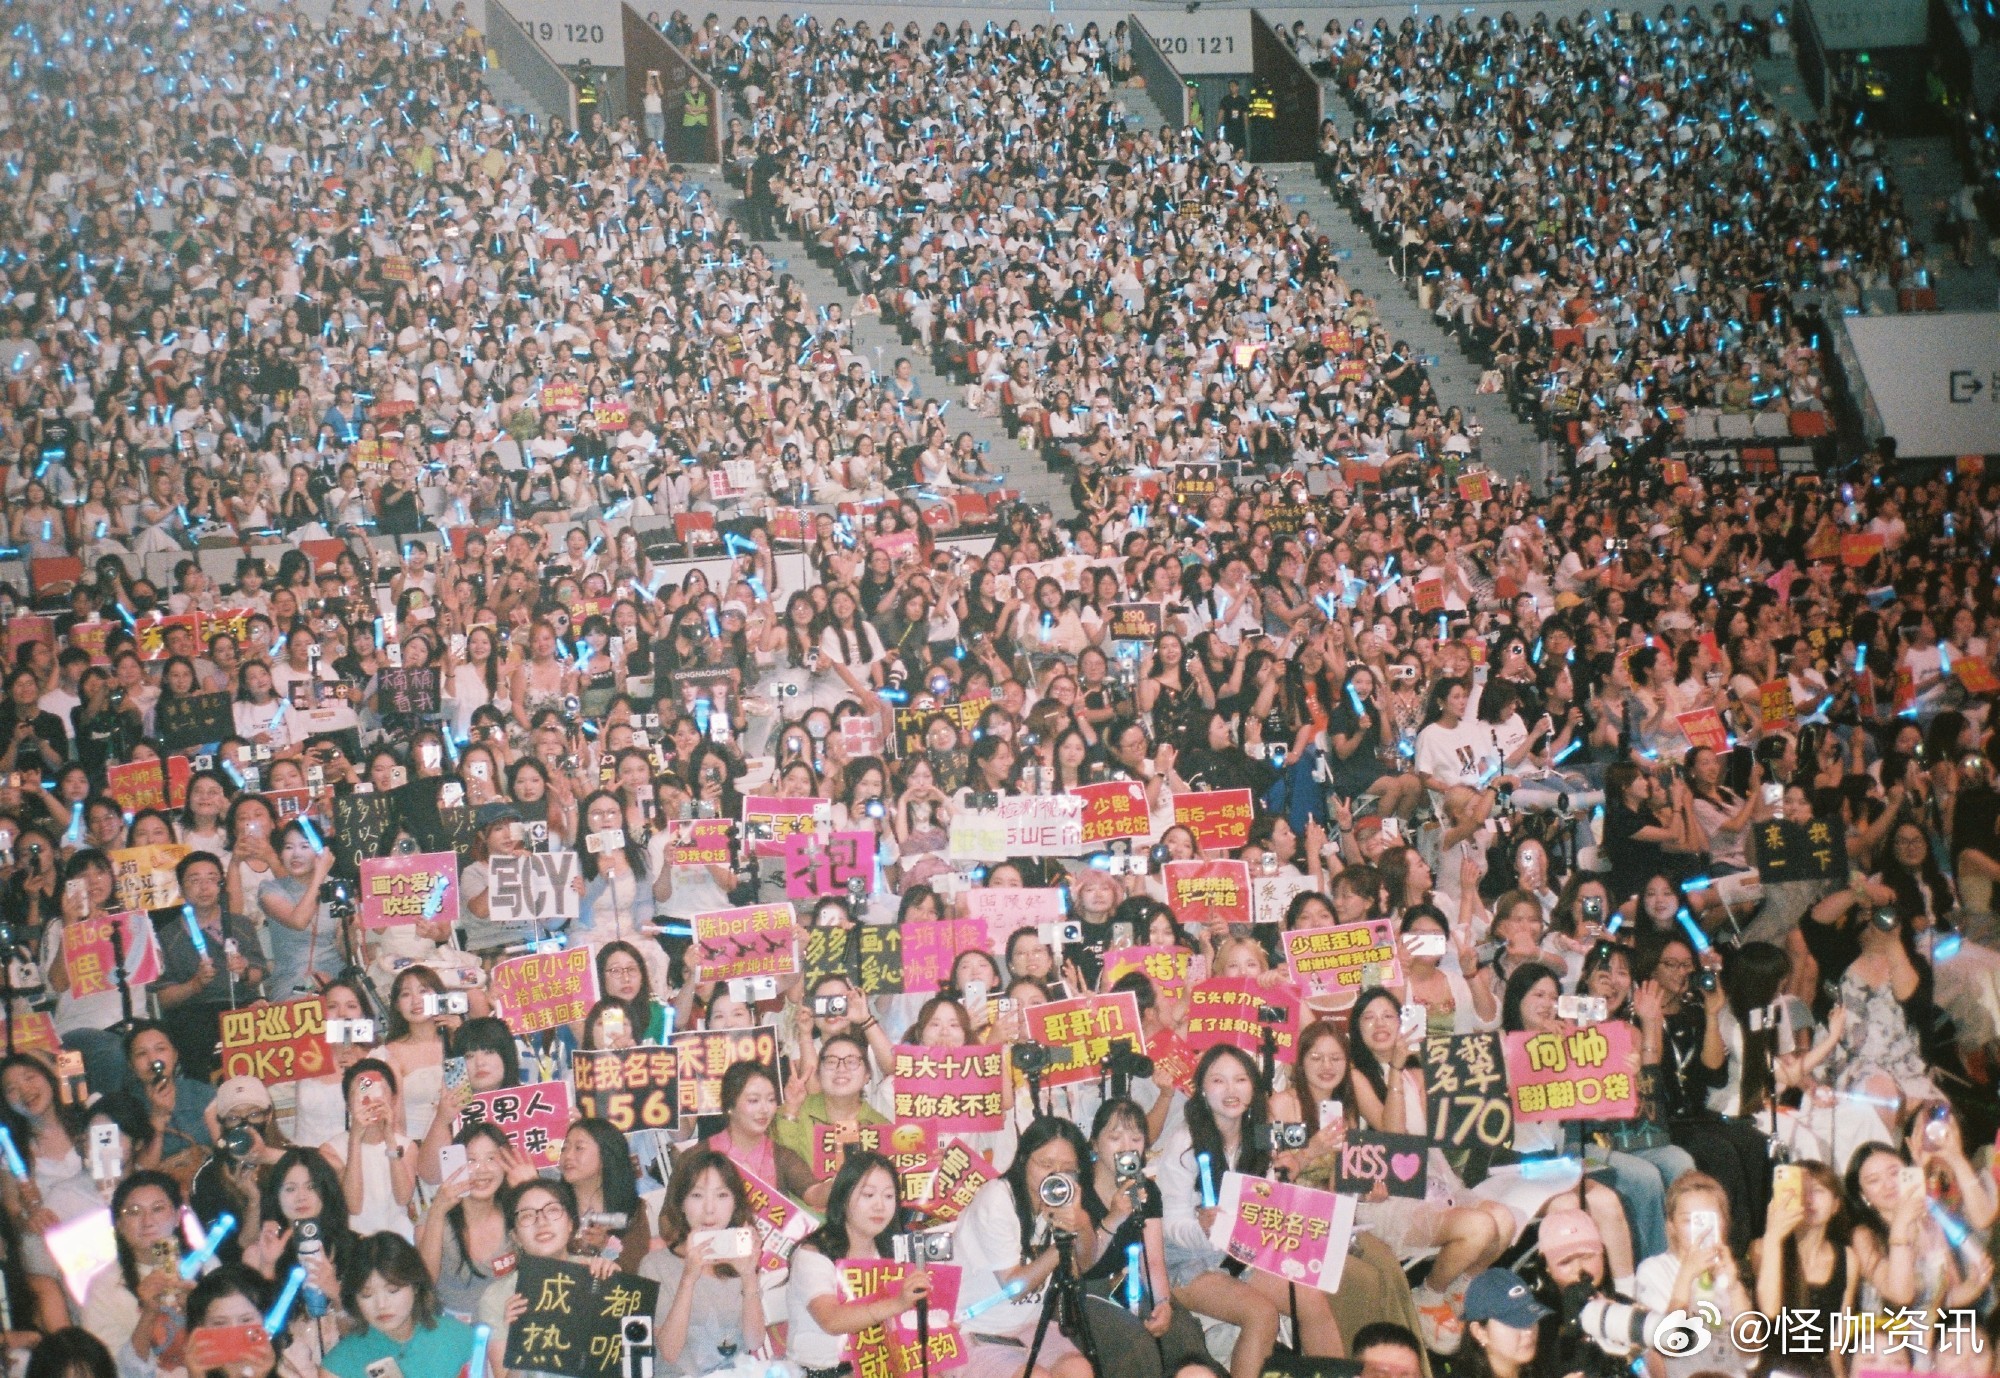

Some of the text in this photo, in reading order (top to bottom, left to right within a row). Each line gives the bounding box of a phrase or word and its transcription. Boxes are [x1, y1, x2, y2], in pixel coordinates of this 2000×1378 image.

[567, 24, 604, 44] 120
[1199, 36, 1234, 54] 121
[497, 949, 588, 990] 小何小何
[223, 1000, 327, 1048] 四巡见
[1043, 1005, 1124, 1041] 哥哥们
[228, 1046, 296, 1080] OK?
[895, 1053, 1001, 1079] 男大十八变
[1525, 1026, 1609, 1072] 何帅
[574, 1053, 676, 1090] 比我名字
[895, 1093, 1002, 1118] 爱你永不变
[1518, 1073, 1631, 1112] 翻翻口袋
[1434, 1096, 1511, 1147] 170
[889, 1152, 928, 1167] ISS
[1241, 1202, 1329, 1240] 写我名字
[1260, 1230, 1300, 1253] YYP
[535, 1272, 641, 1318] 成都
